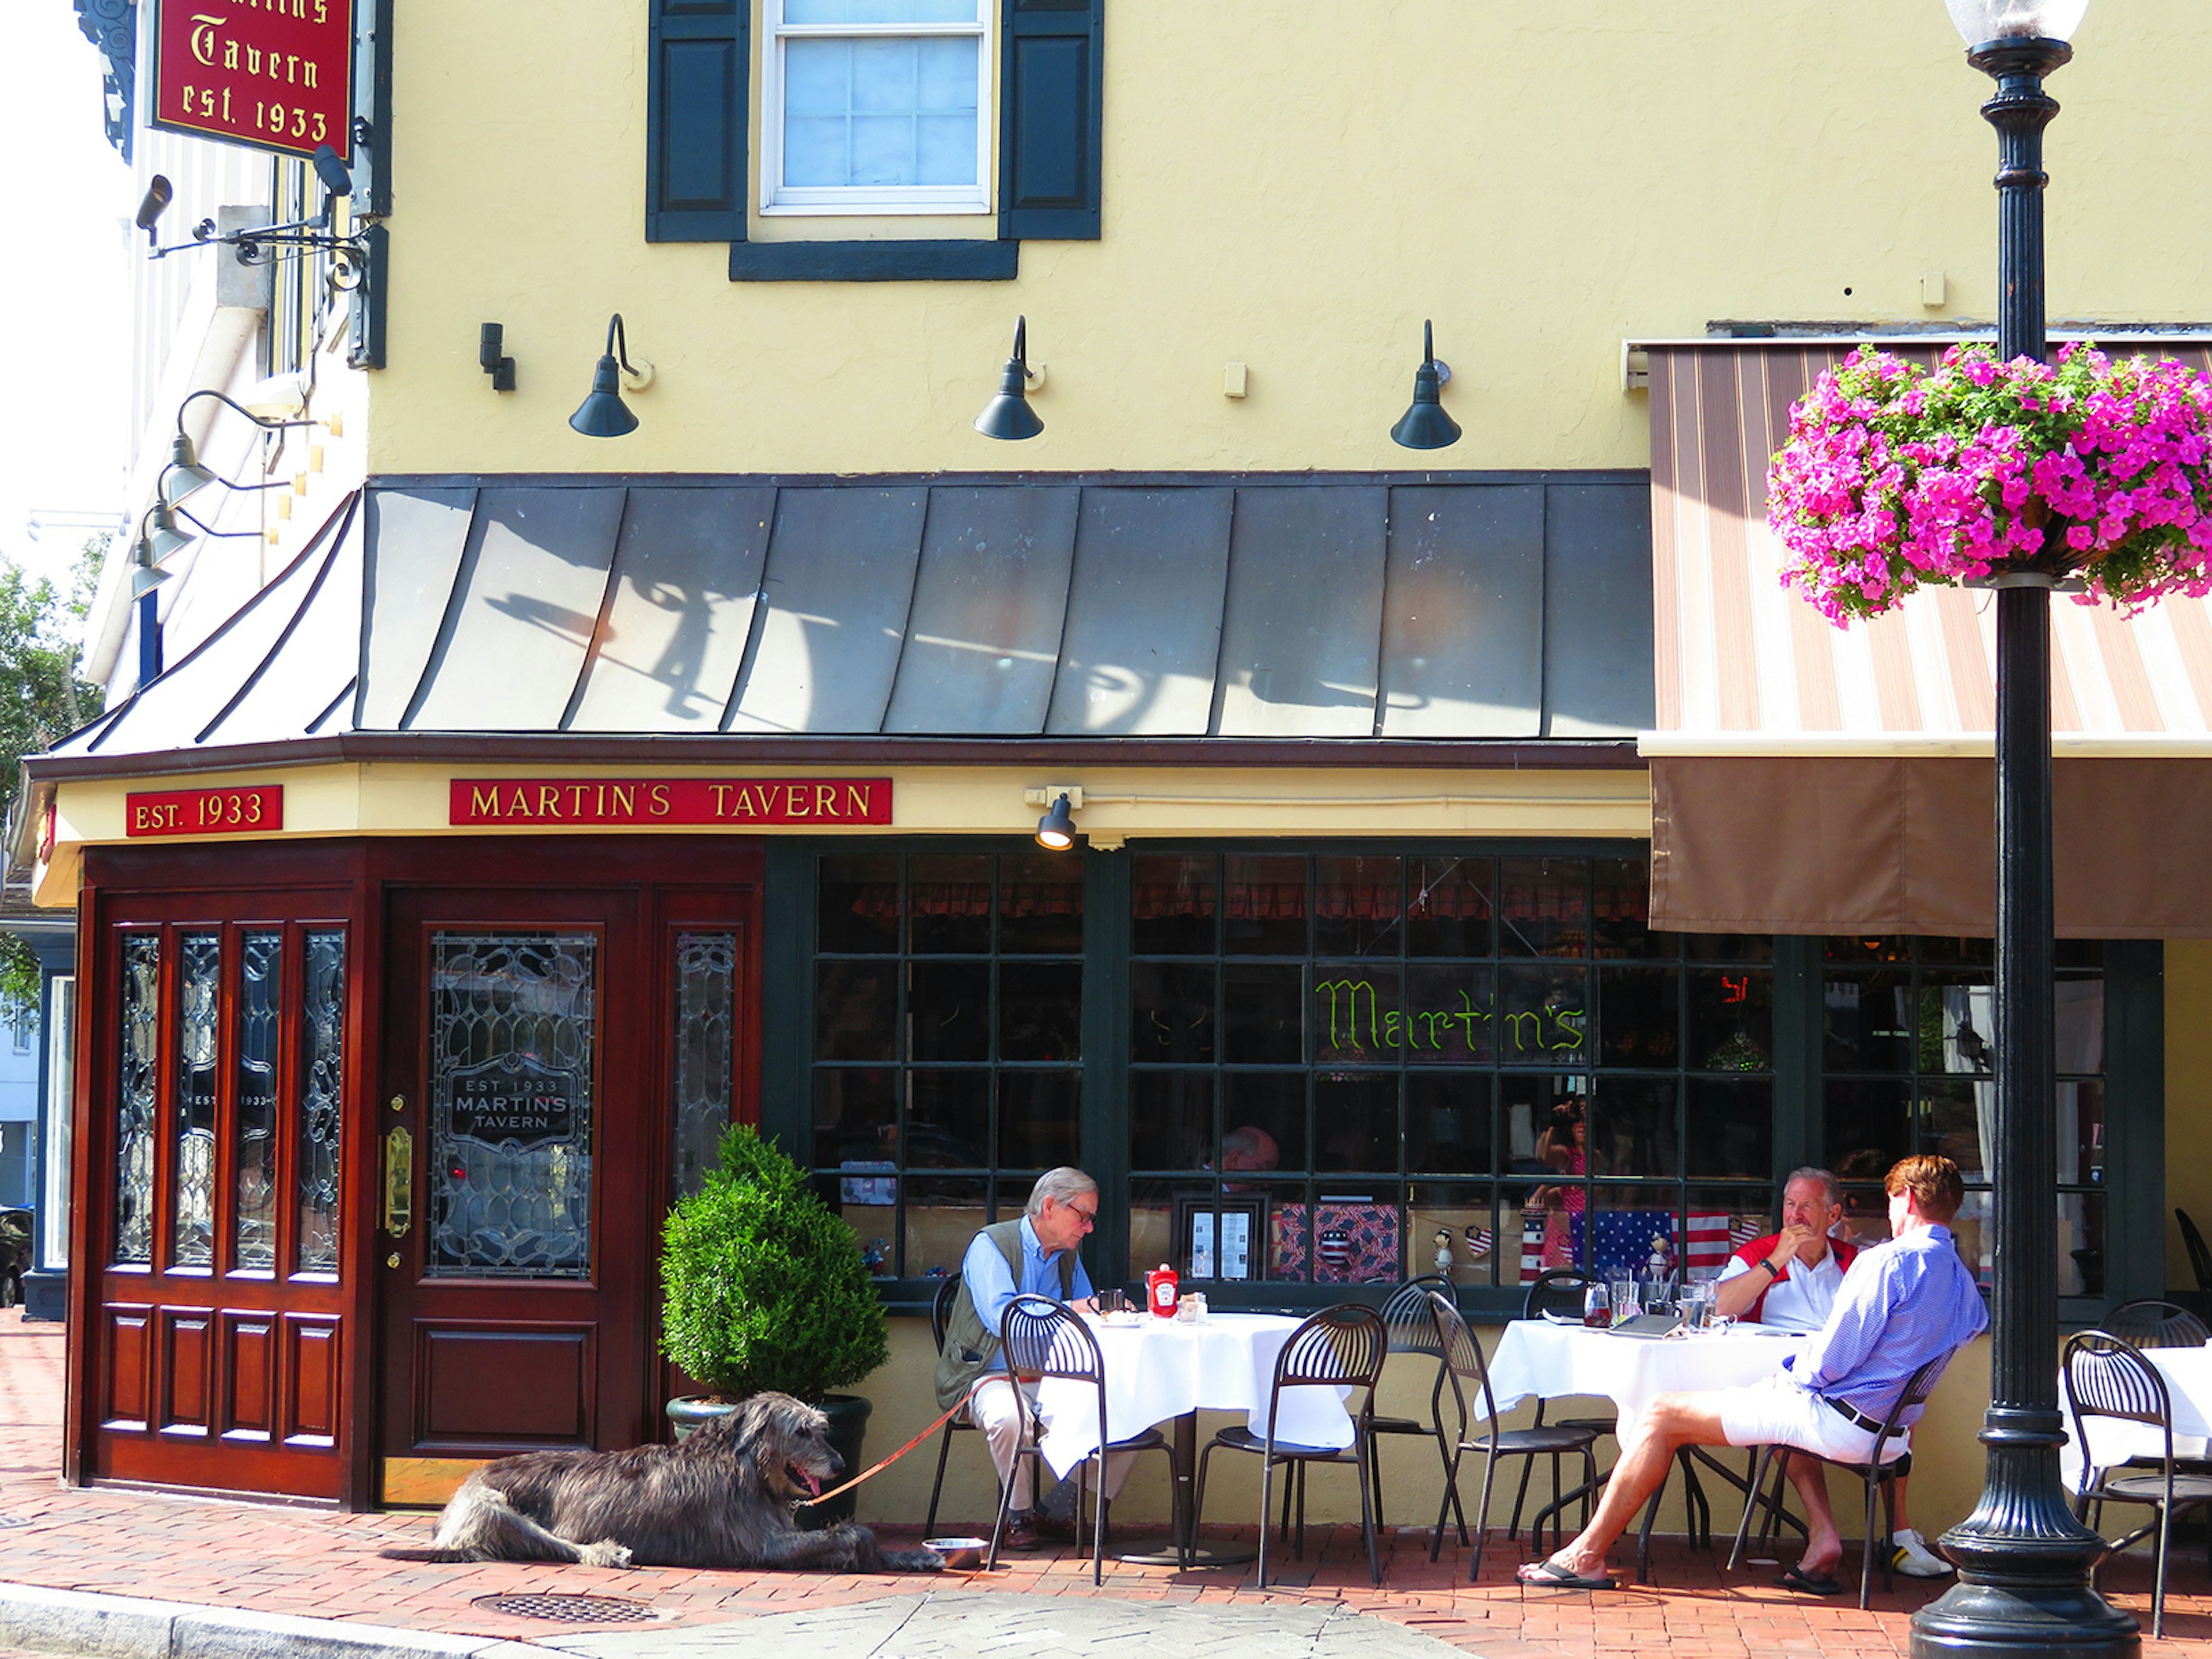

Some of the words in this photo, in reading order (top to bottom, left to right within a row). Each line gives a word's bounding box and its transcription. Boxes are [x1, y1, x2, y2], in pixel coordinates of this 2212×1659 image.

[190, 14, 318, 89] Tavern
[182, 85, 236, 124] est.
[256, 101, 327, 142] 1933
[136, 804, 184, 829] EST.
[198, 793, 261, 825] 1933
[469, 785, 671, 817] MARTIN'S
[708, 785, 870, 817] TAVERN
[466, 1080, 499, 1092] EST
[513, 1080, 557, 1092] 1933
[241, 1095, 266, 1105] 1933
[457, 1096, 566, 1112] MARTIN'S
[475, 1116, 547, 1127] TAVERN
